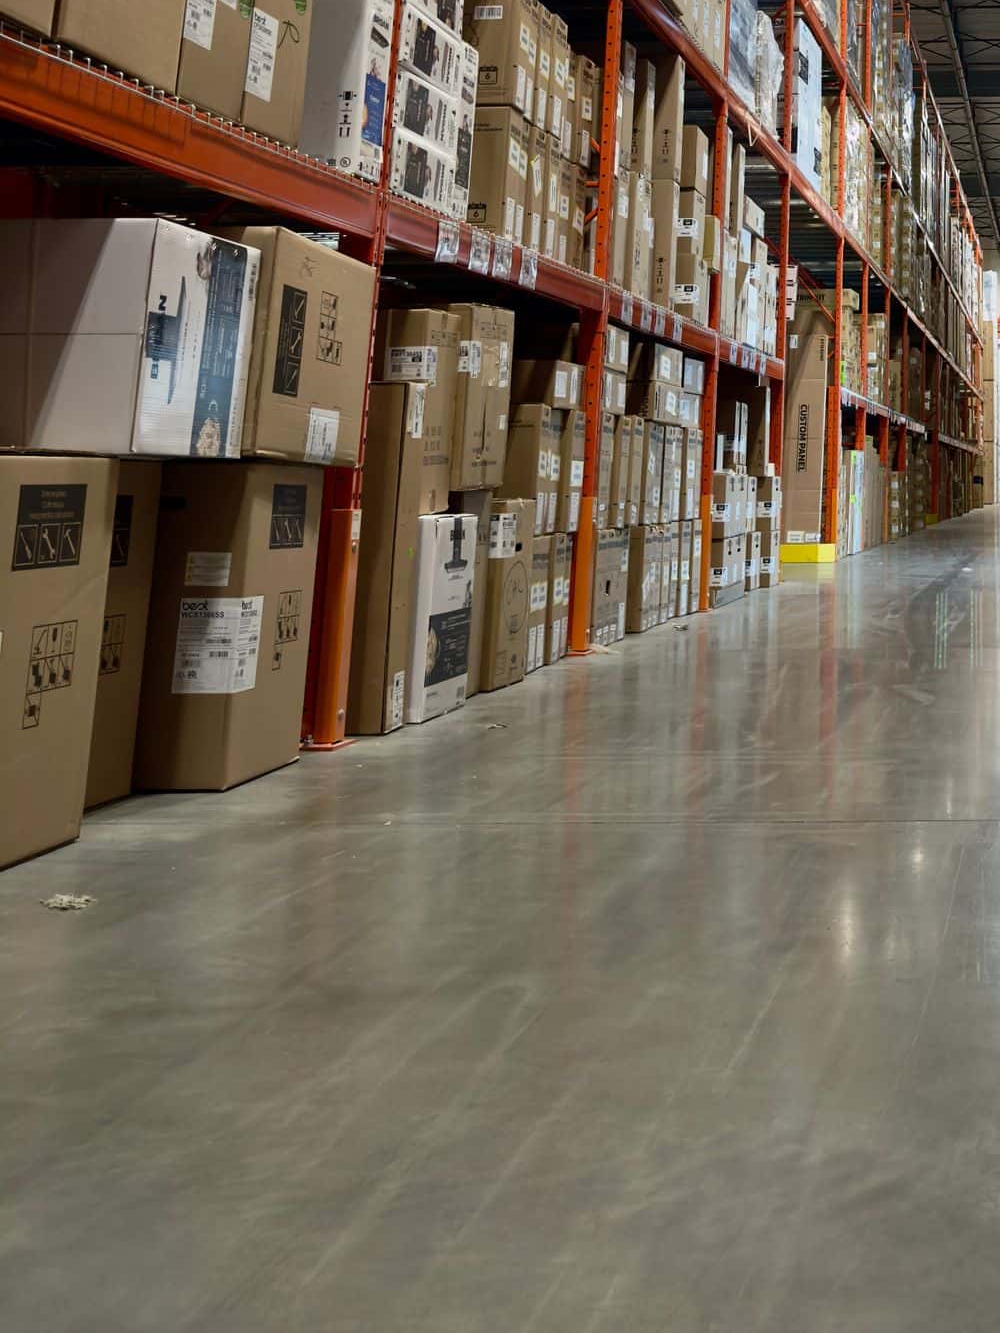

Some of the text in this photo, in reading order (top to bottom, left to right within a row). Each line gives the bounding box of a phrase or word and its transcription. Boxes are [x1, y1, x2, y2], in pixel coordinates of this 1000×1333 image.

[798, 404, 809, 472] CUSTOM PANEL
[182, 600, 209, 611] best
